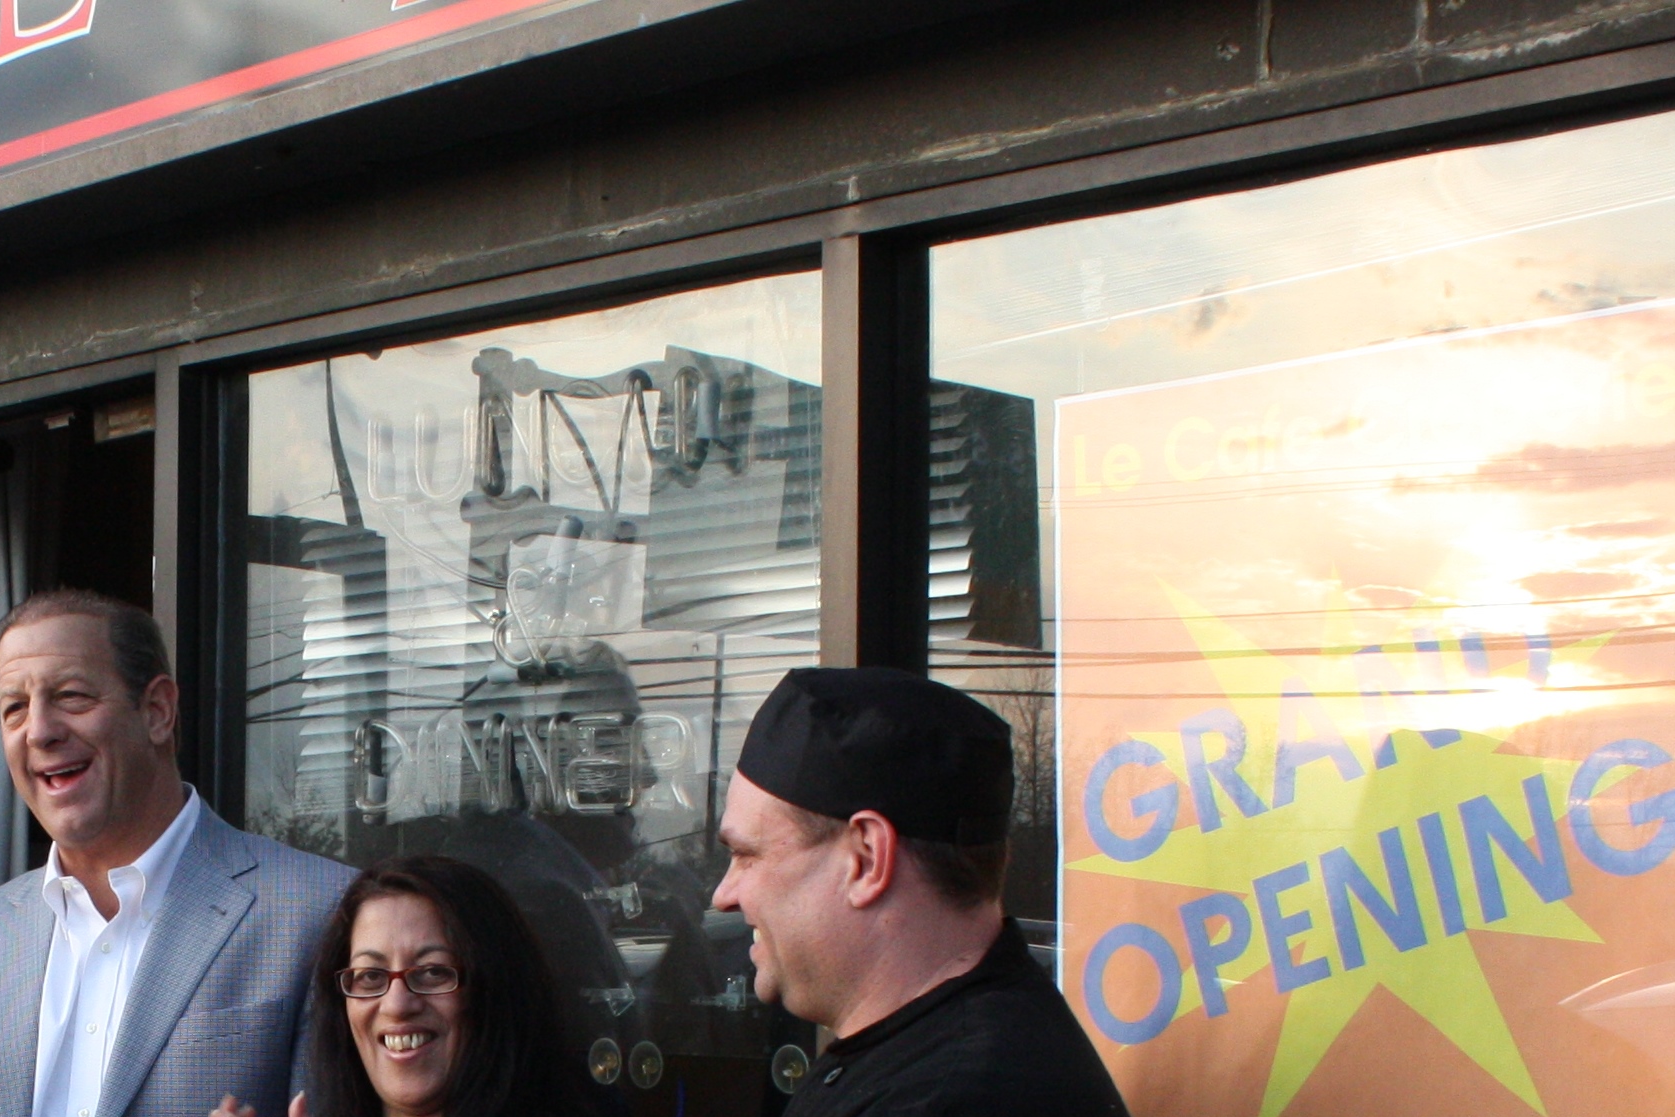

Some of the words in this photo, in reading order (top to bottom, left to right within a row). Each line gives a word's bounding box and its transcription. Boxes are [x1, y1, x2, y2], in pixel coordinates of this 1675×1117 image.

[1074, 434, 1141, 497] Le
[354, 712, 695, 815] DINNER
[1083, 737, 1675, 1045] OPENING
